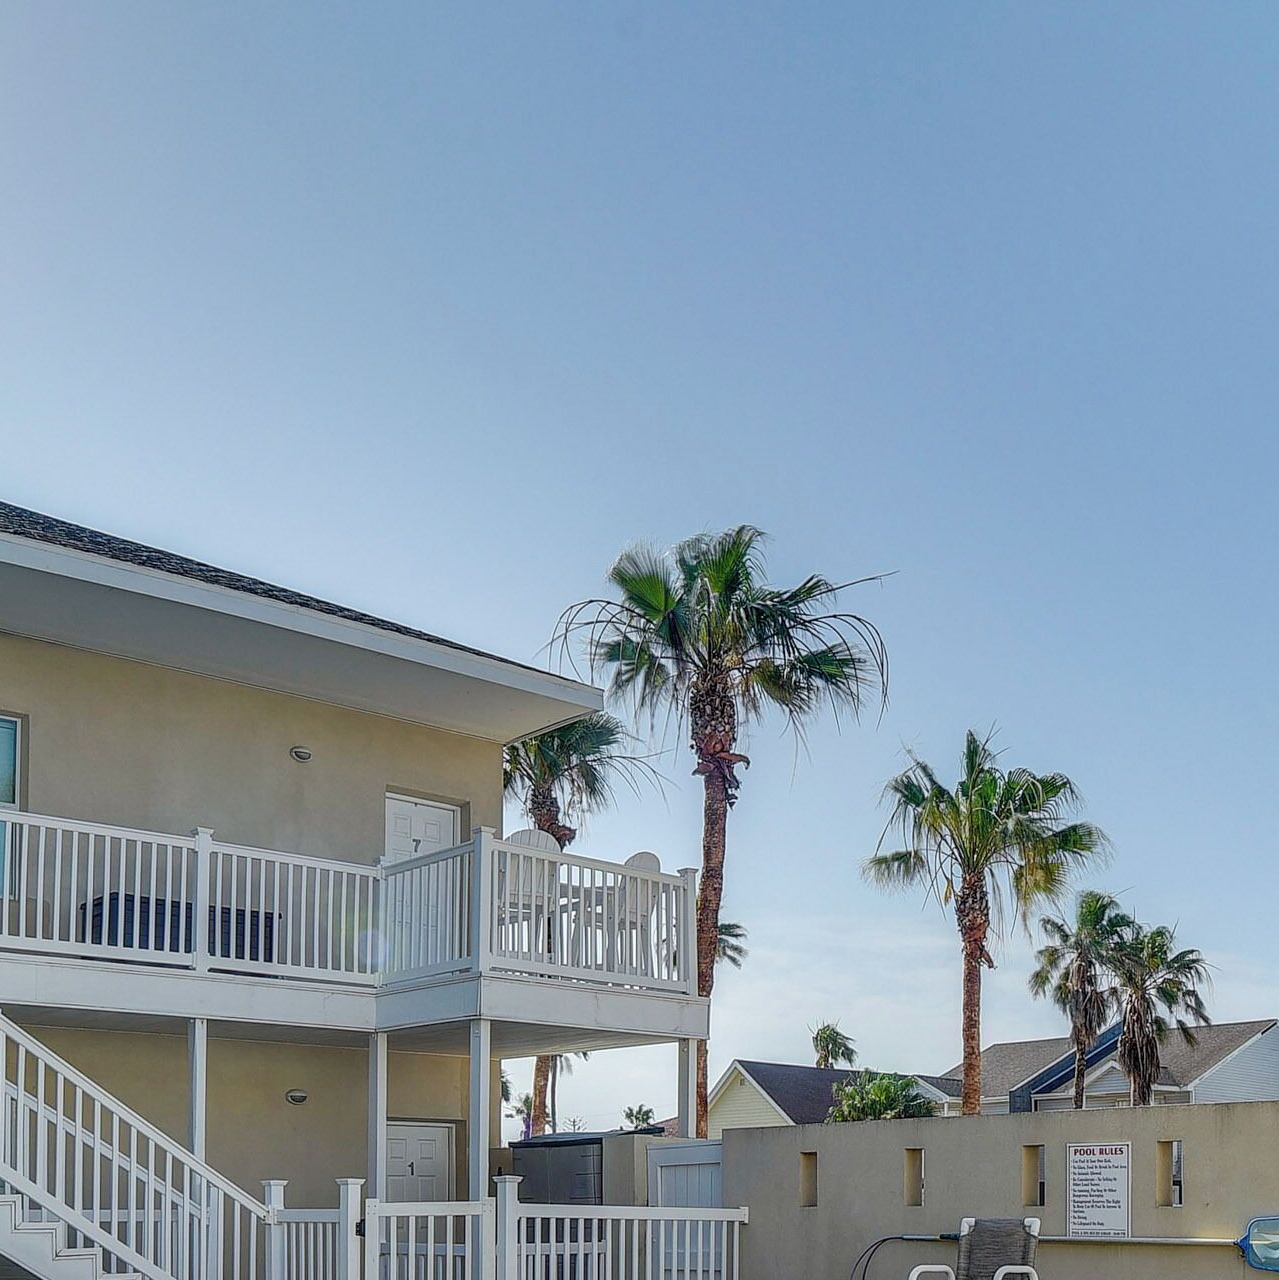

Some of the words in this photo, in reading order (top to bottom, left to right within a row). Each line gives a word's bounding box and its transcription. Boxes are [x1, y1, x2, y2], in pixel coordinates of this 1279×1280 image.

[412, 838, 422, 853] 7
[1073, 1148, 1097, 1156] POOL
[1099, 1147, 1124, 1156] RULES
[407, 1161, 414, 1176] 1
